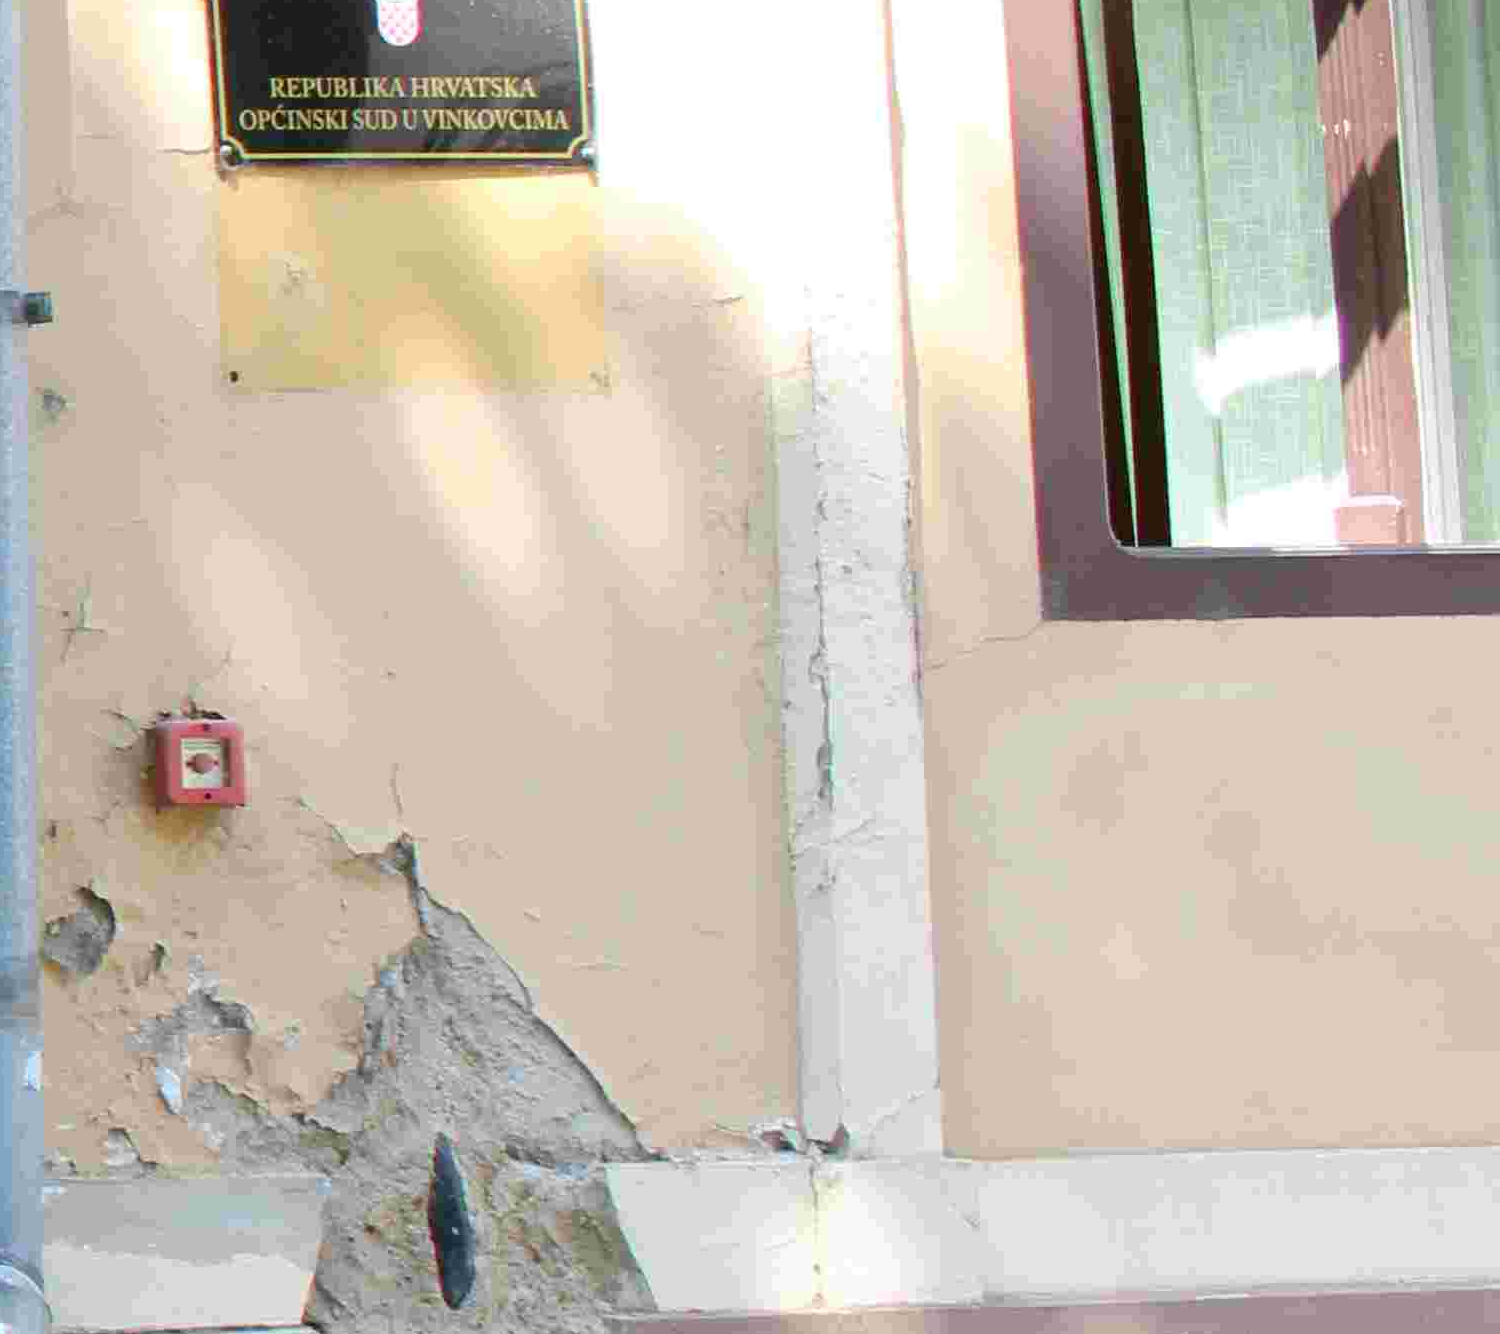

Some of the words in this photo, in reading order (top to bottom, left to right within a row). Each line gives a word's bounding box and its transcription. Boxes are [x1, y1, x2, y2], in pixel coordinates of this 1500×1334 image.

[269, 76, 405, 98] REPUBLIKA
[411, 76, 537, 98] HRVATSKA
[238, 104, 349, 130] OPĆINSKI
[352, 109, 396, 130] SUD
[402, 109, 420, 130] U
[421, 108, 571, 130] VINKOVCIMA
